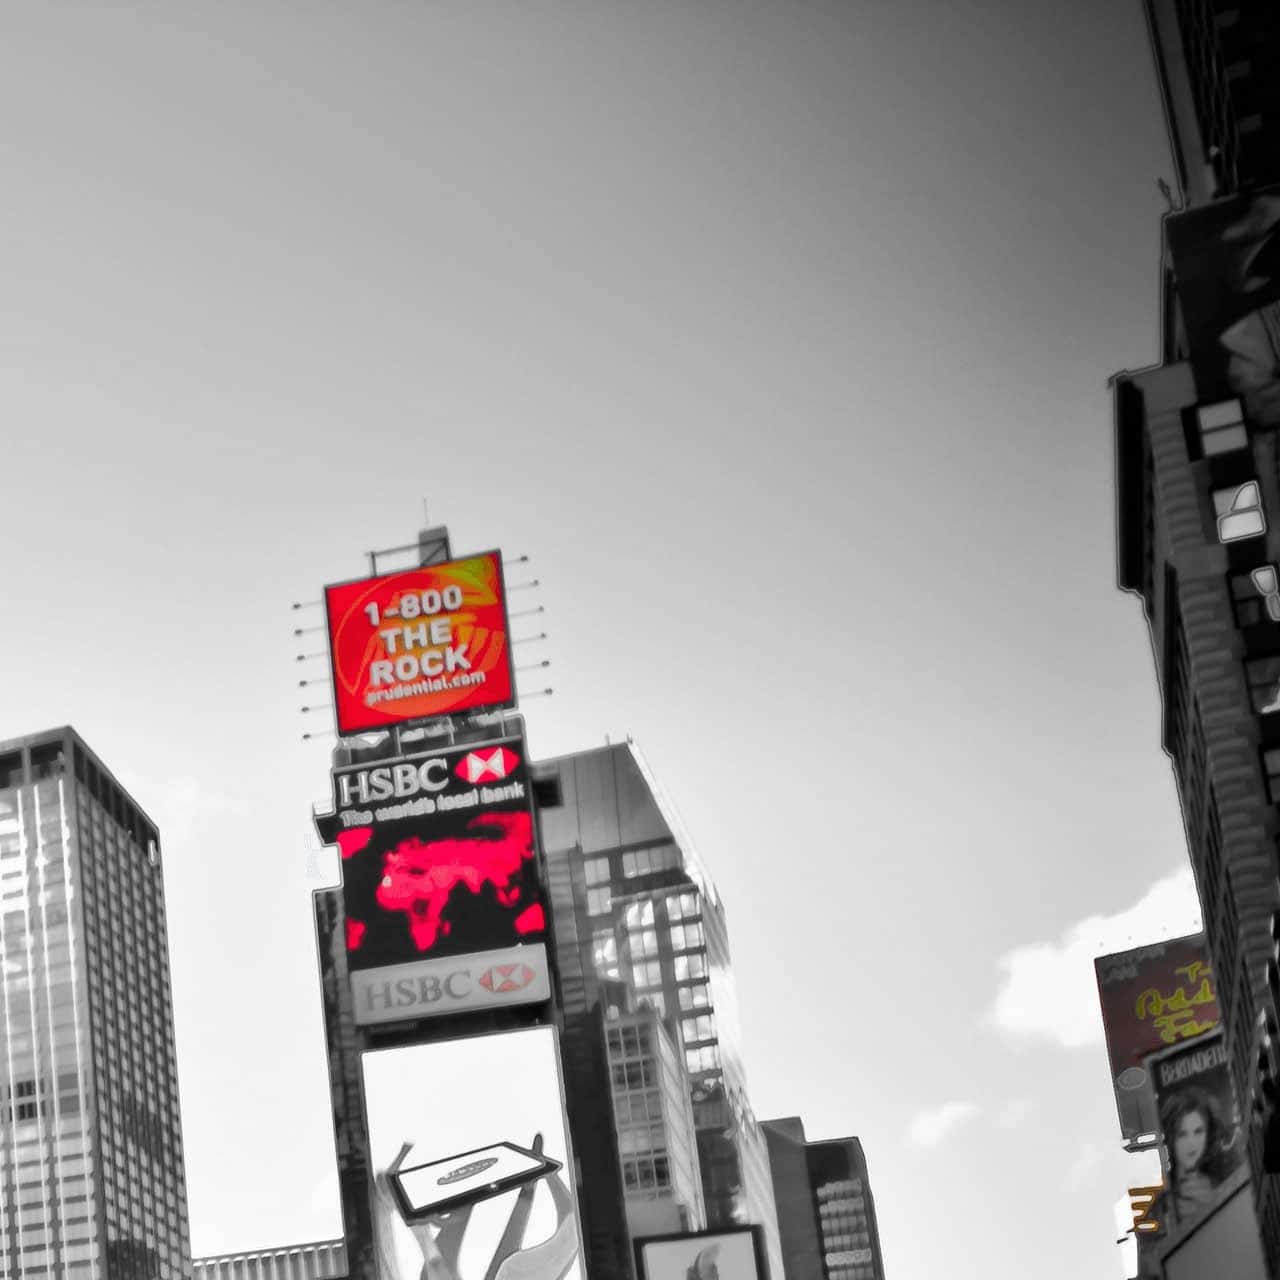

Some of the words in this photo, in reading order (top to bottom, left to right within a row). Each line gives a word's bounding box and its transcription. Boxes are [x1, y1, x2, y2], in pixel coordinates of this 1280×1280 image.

[363, 585, 464, 628] 1-800
[379, 618, 454, 655] THE
[369, 645, 473, 687] ROCK
[366, 670, 487, 706] prudential.com
[339, 758, 450, 807] HSBC
[480, 781, 525, 804] bank
[361, 969, 475, 1012] HSBC
